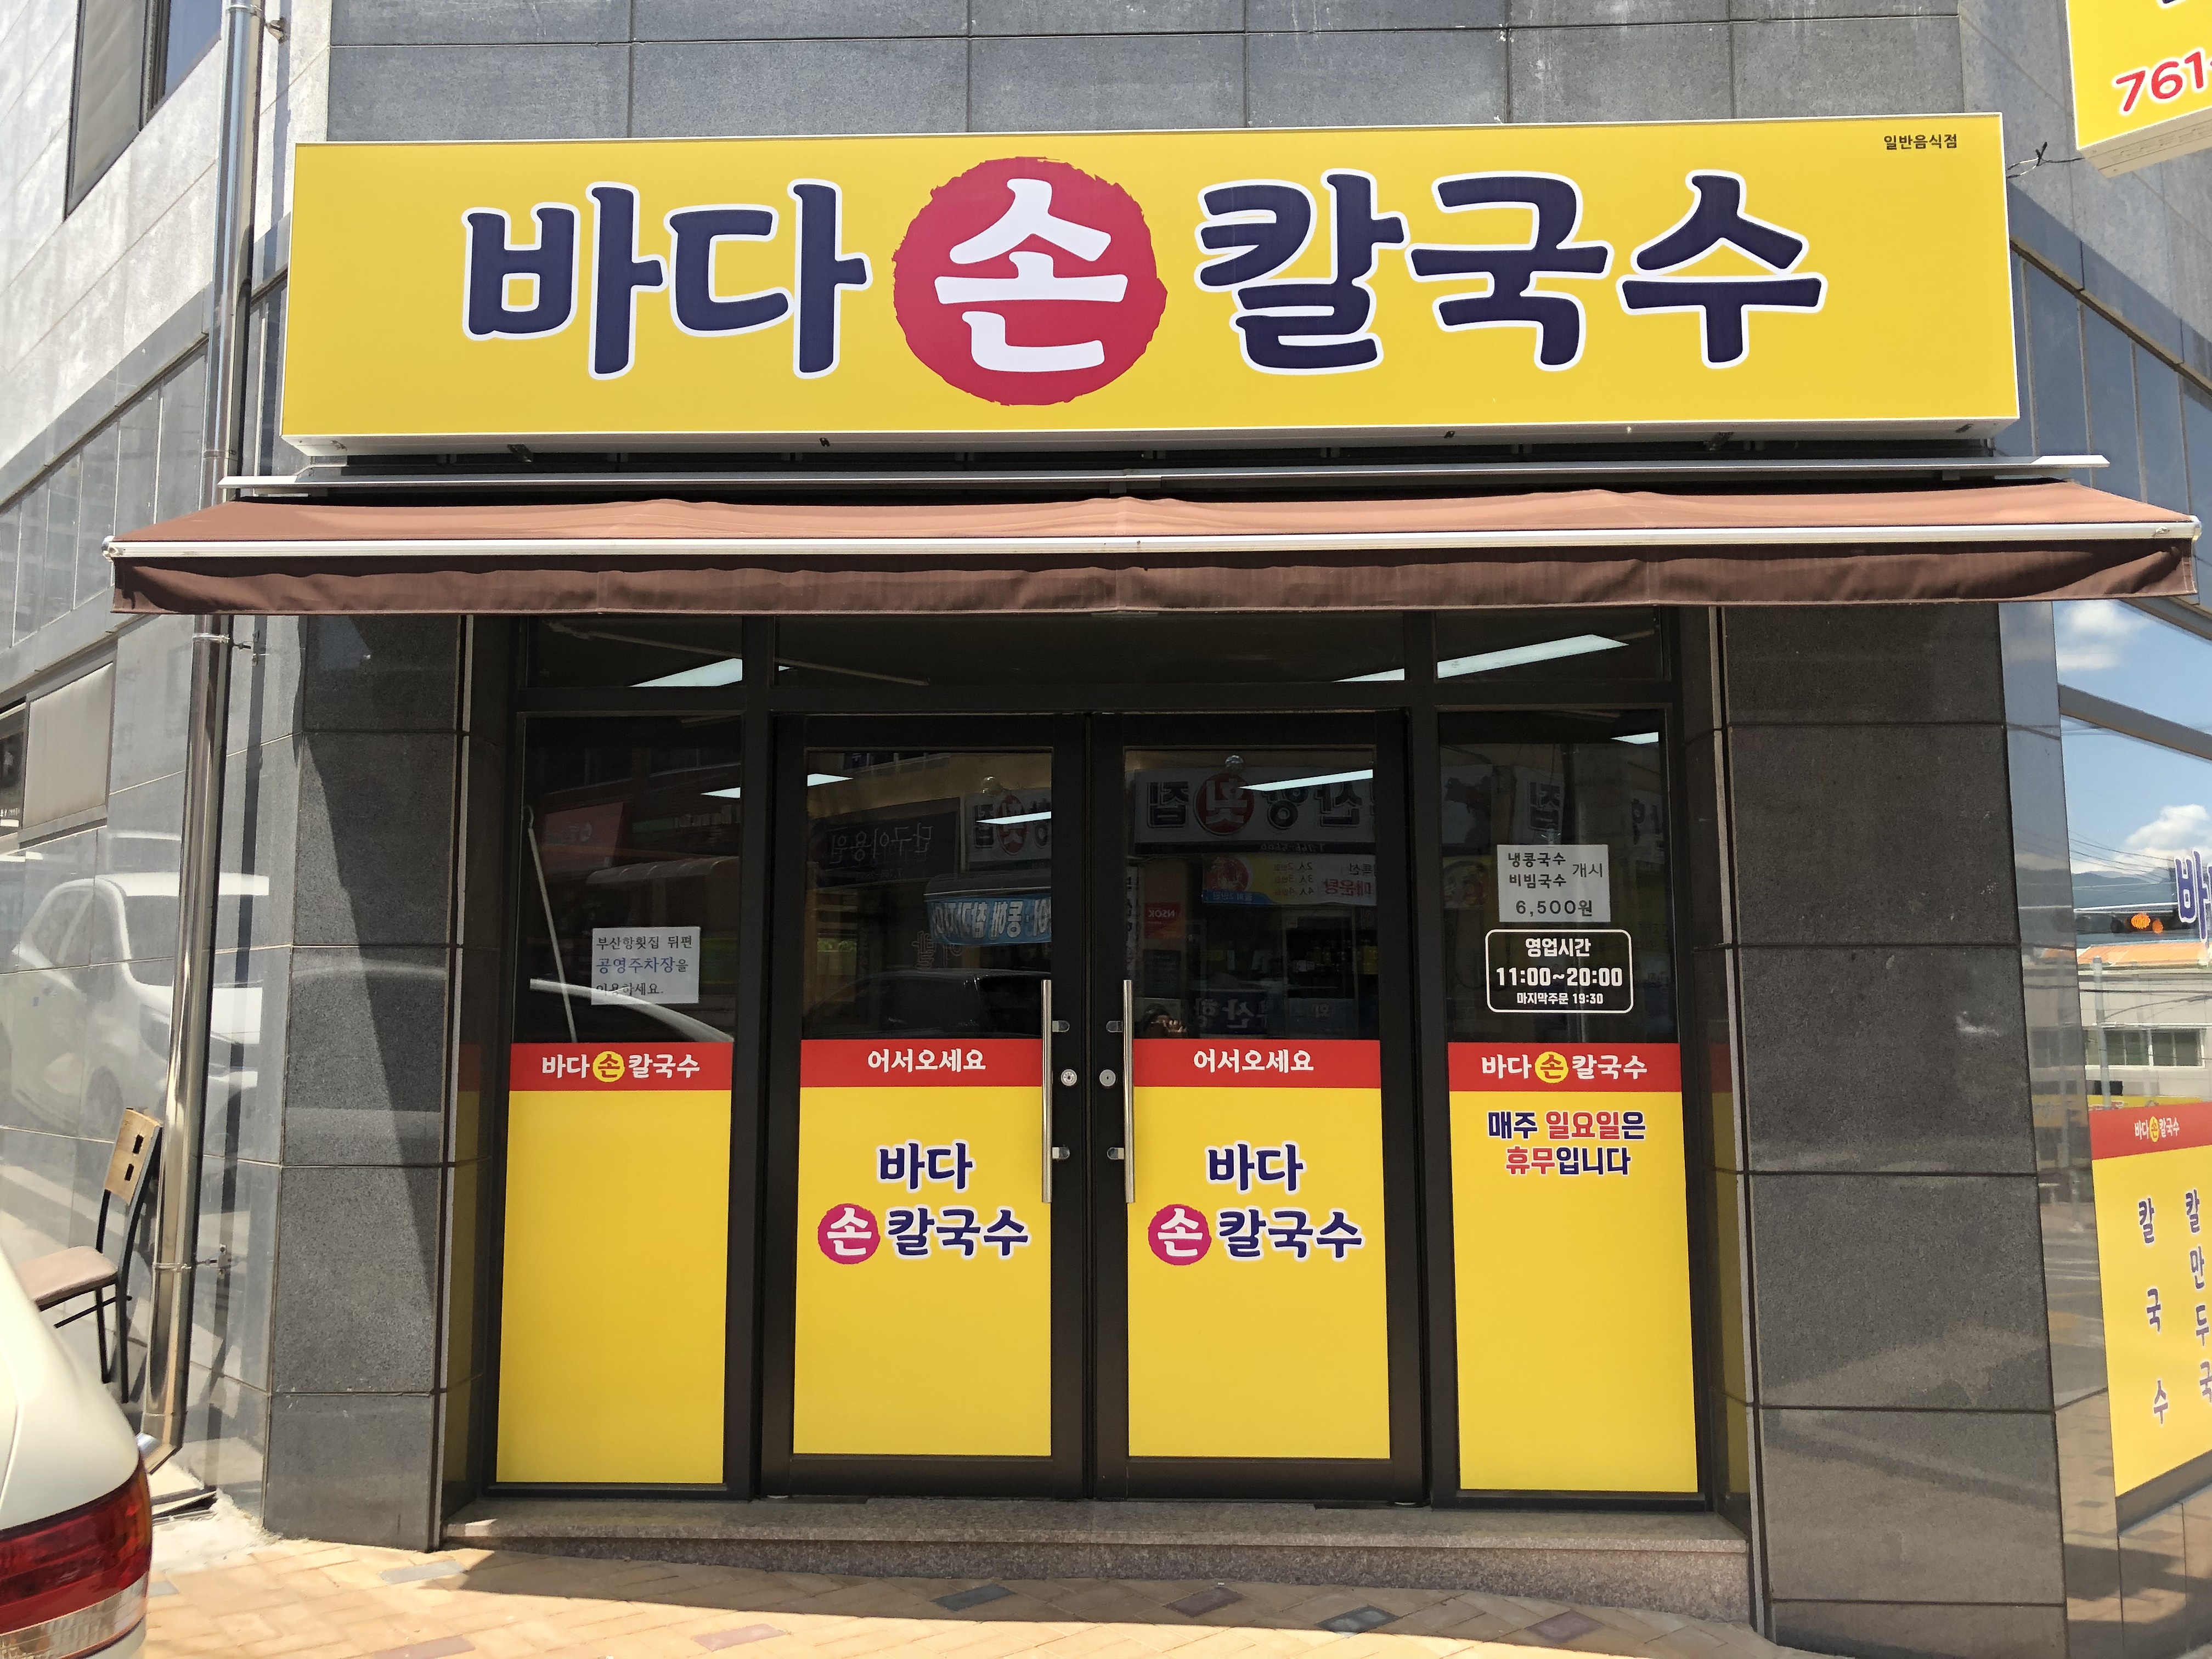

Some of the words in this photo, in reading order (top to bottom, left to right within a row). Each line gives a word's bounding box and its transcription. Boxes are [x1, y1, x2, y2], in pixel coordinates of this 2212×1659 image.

[2116, 50, 2212, 112] 761
[1883, 133, 1958, 150] 일반음식점
[466, 182, 869, 375] 바다
[1198, 172, 1824, 370] 칼국수
[1508, 852, 1566, 868] 냉콩국수
[1572, 862, 1603, 878] 개시
[1509, 873, 1567, 889] 비빔국수
[1515, 899, 1593, 917] 6,500원
[2174, 848, 2212, 943] 바
[596, 935, 659, 950] 부산항횟집
[667, 935, 692, 949] 뒤편
[1525, 938, 1592, 957] 영업시간
[595, 956, 689, 974] 공영주차장을
[1496, 967, 1623, 986] 11:00~20:00
[1516, 992, 1569, 1005] 마지막주문
[1572, 993, 1604, 1005] 19:30
[867, 1048, 986, 1073] 어서오세요
[1193, 1048, 1314, 1074] 어서오세요
[1487, 1110, 1538, 1141] 매주
[1545, 1109, 1646, 1140] 일요일은
[876, 1141, 975, 1192] 바다
[1206, 1142, 1306, 1193] 바다
[1505, 1145, 1632, 1176] 휴무입니다
[886, 1206, 1030, 1259] 칼국수
[1218, 1208, 1364, 1260] 칼국수
